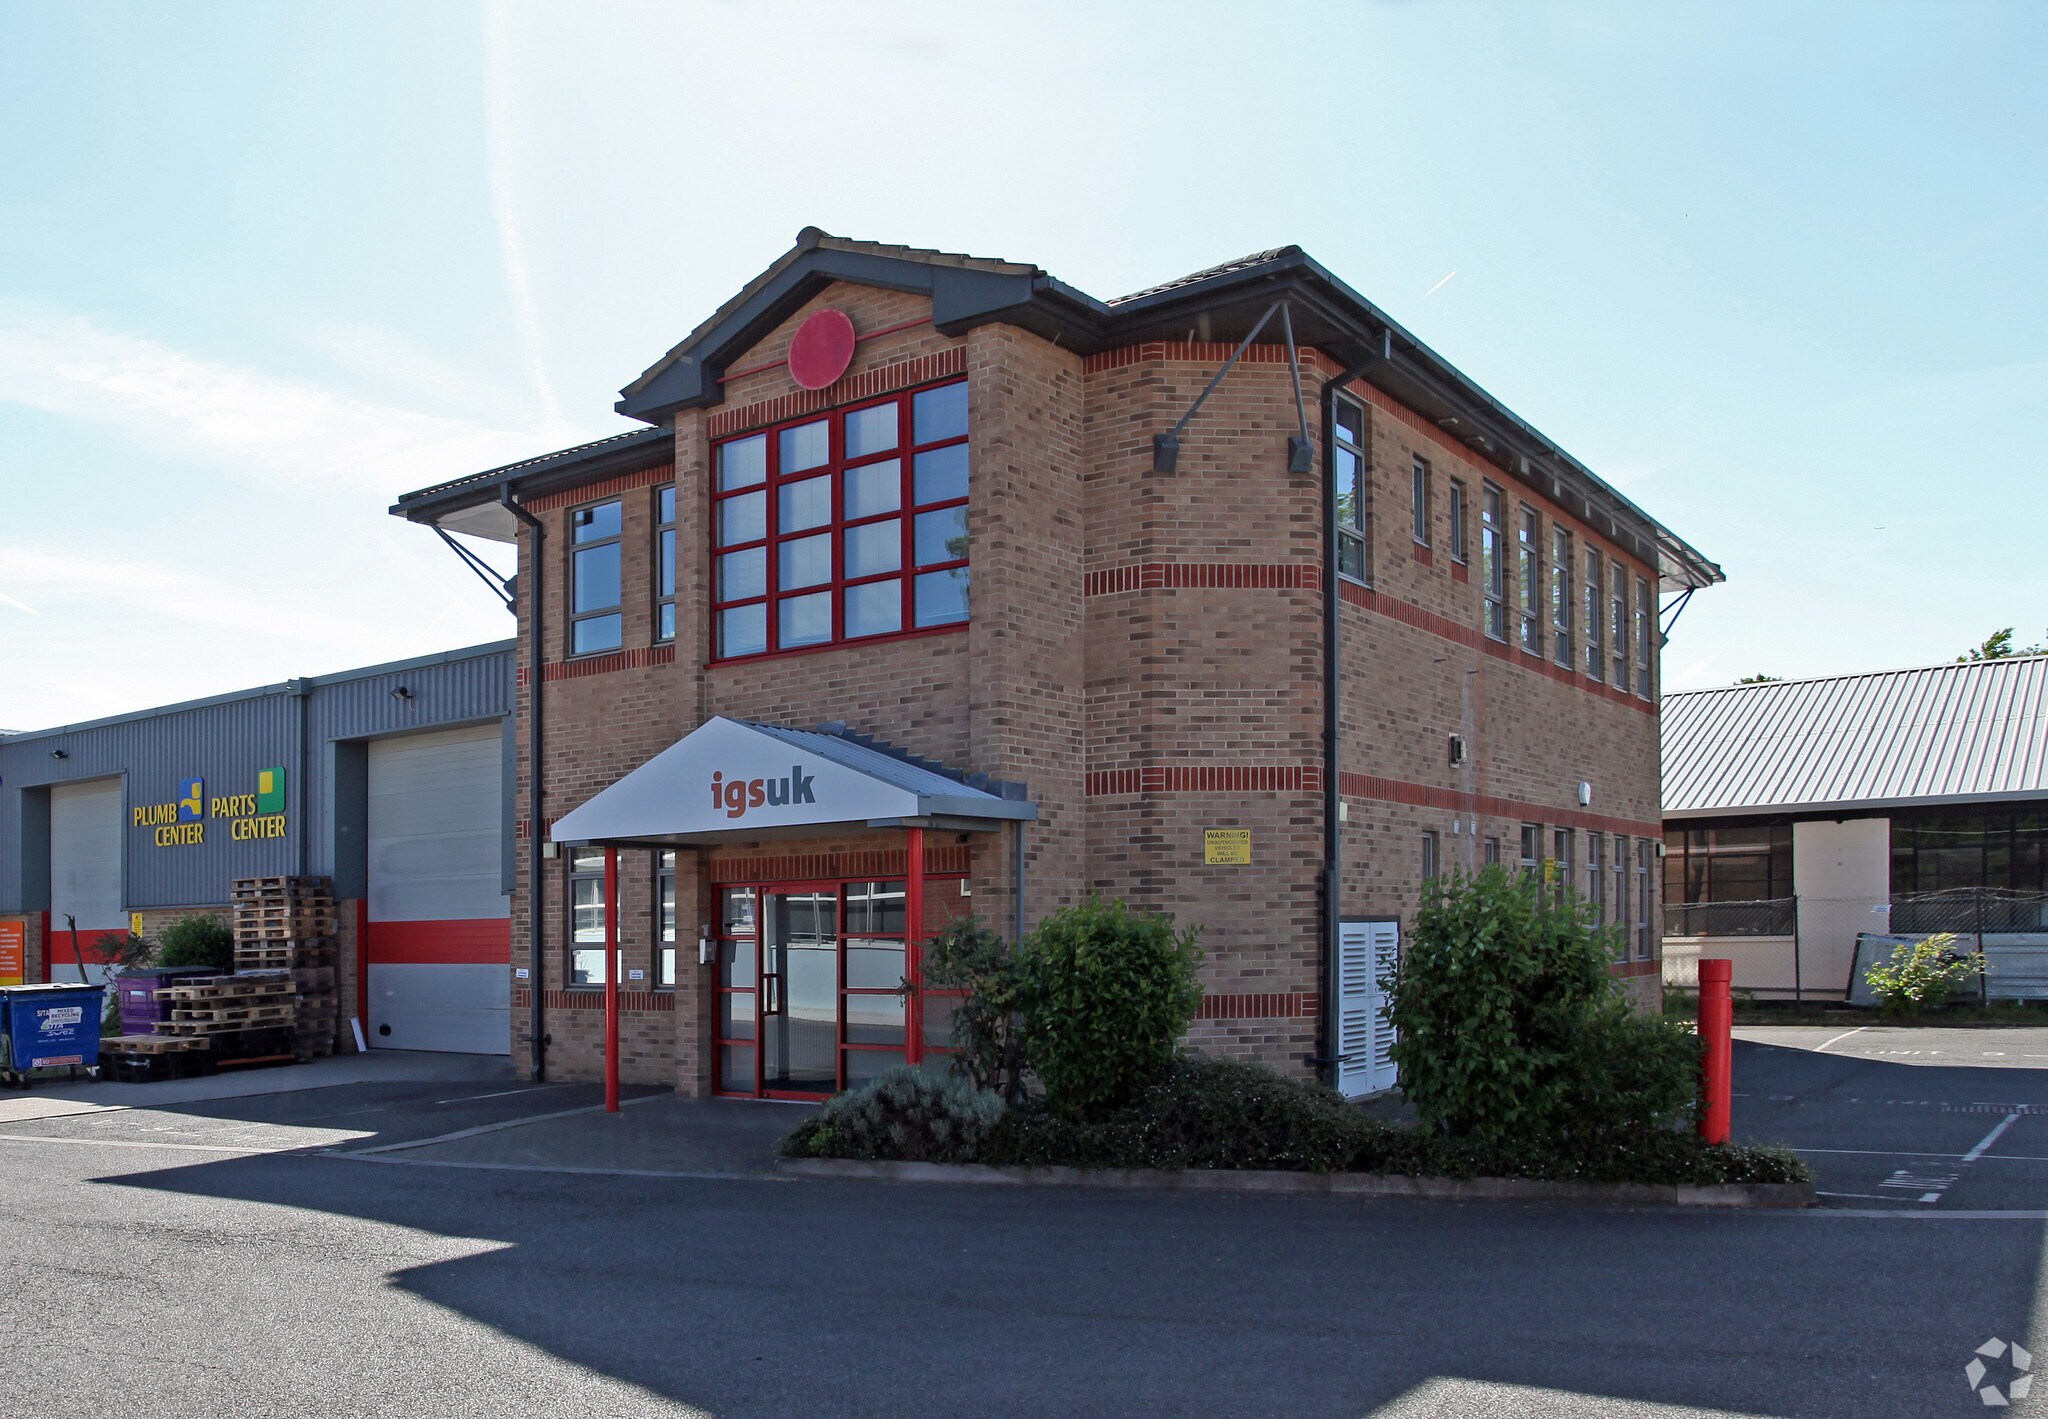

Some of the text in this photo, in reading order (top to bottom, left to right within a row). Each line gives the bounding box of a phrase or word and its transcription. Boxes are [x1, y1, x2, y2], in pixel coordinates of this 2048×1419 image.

[710, 765, 816, 819] igsuk
[133, 803, 178, 827] PLUMB
[211, 794, 256, 818] PARTS
[154, 823, 204, 847] CENTER
[231, 815, 286, 841] CENTER
[1207, 831, 1248, 839] WARNING!
